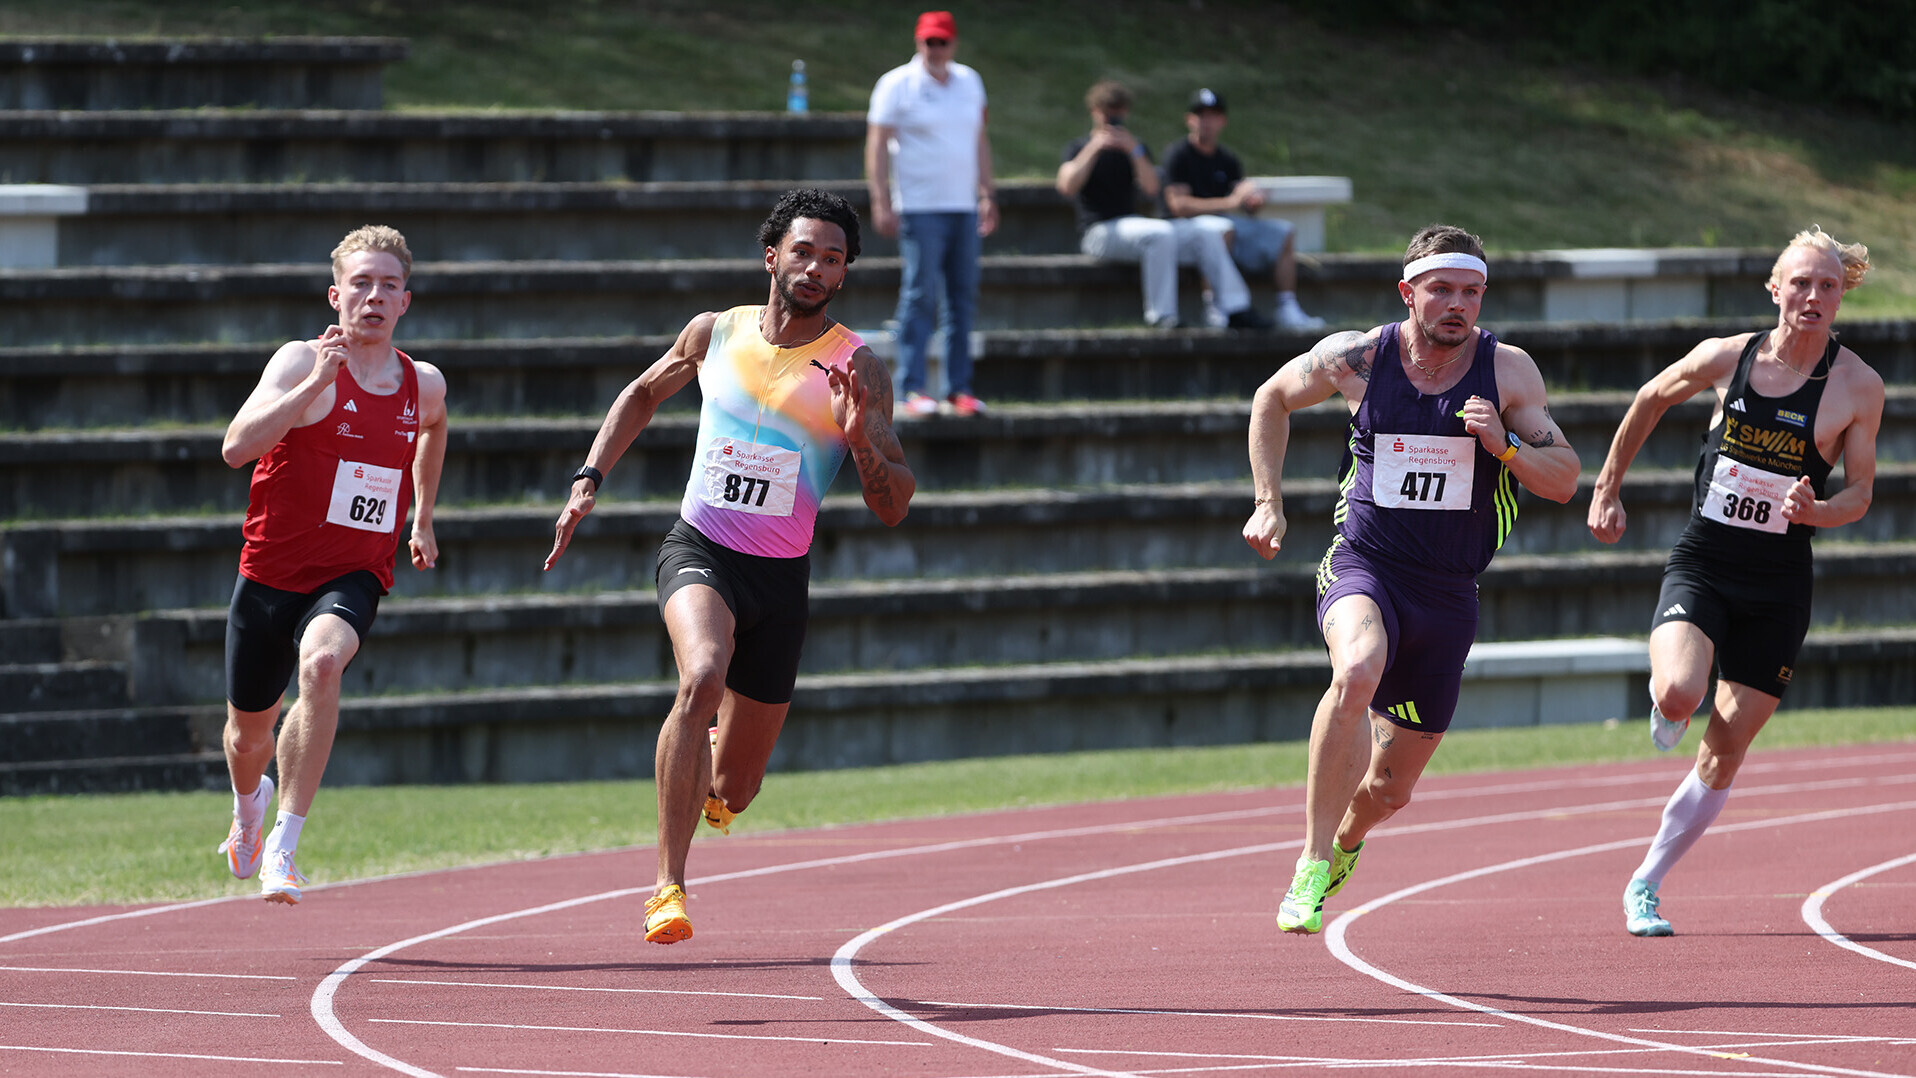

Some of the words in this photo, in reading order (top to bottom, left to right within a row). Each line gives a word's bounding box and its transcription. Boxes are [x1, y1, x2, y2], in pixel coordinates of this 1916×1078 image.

[1777, 409, 1805, 422] BECK
[736, 449, 775, 463] Sparkasse
[1408, 445, 1449, 455] Sparkasse
[734, 459, 780, 475] Regensburg
[1408, 456, 1456, 467] Regensburg
[723, 473, 770, 507] 877
[1400, 471, 1447, 502] 477
[349, 494, 387, 525] 629
[1722, 493, 1772, 524] 368
